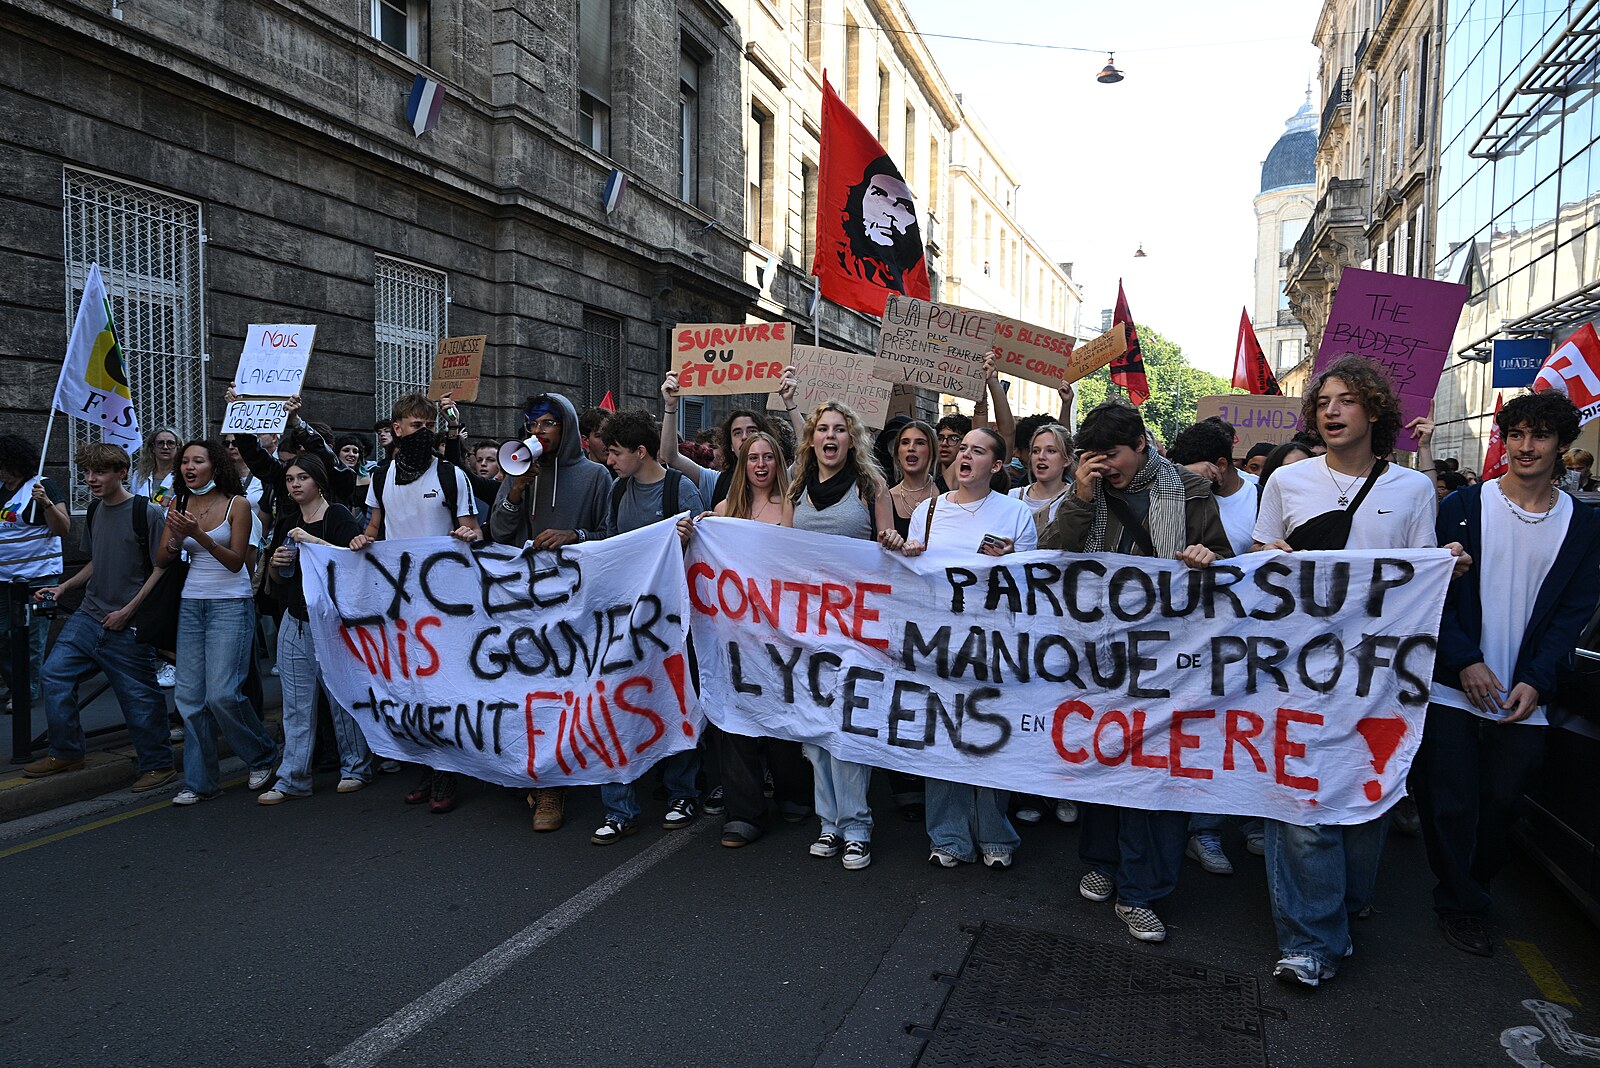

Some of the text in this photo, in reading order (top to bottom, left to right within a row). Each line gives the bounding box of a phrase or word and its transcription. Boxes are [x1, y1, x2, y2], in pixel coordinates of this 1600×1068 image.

[888, 297, 992, 341] LA POLICE
[1365, 293, 1413, 324] THE
[261, 329, 299, 348] NOUS
[438, 338, 481, 354] LA JEUNESSE
[897, 327, 948, 343] EST PLUS
[1017, 327, 1073, 358] BLESSÉS
[1333, 323, 1428, 360] BADDEST
[441, 355, 471, 369] EMMERDE
[703, 349, 734, 363] OU
[809, 350, 838, 367] LIEU
[843, 356, 864, 371] DE
[880, 349, 983, 380] ETUDIANTS QUE LES
[1006, 351, 1025, 365] DE
[1025, 358, 1066, 380] COURS
[1500, 358, 1543, 369] UNADEV
[807, 378, 842, 390] GOSSES
[902, 366, 964, 391] VIOLEURS
[230, 402, 288, 417] FAUT PAS
[1219, 405, 1298, 429] COMPTE
[945, 557, 1415, 623] PARCOURSUP
[687, 561, 892, 650] CONTRE
[902, 621, 1439, 707] MANQUE DE PROFS
[727, 640, 1013, 756] LYCEENS
[1021, 714, 1045, 732] EN
[1051, 699, 1325, 792] COLERE
